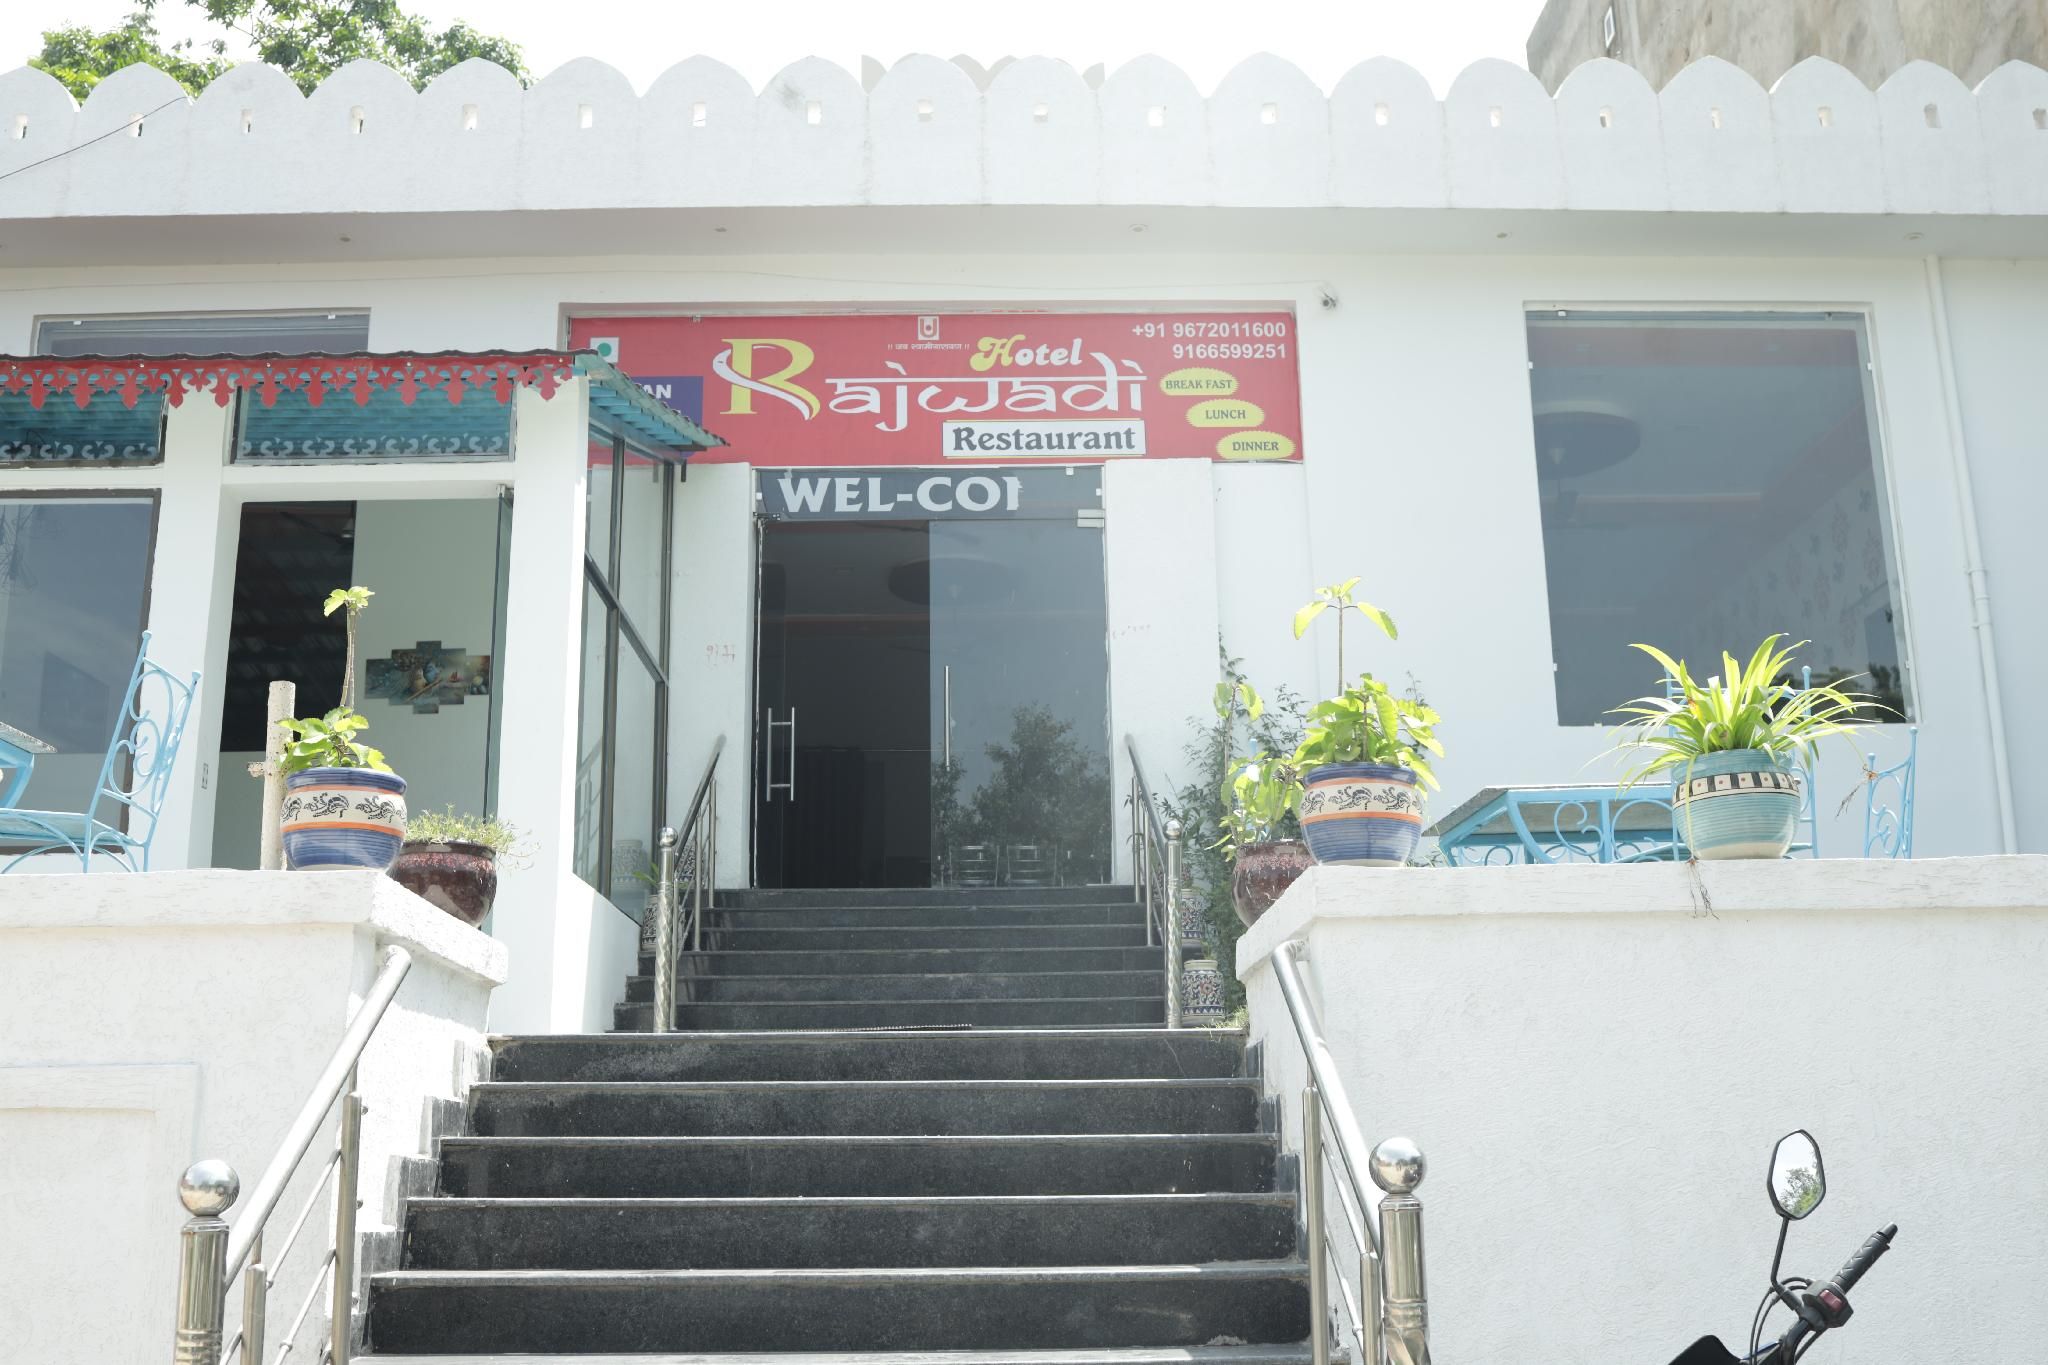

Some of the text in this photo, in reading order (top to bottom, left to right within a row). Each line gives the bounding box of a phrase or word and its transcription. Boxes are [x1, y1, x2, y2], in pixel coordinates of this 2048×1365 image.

[1132, 323, 1287, 338] +91 9672011600
[969, 334, 1083, 372] Hotel
[1172, 343, 1287, 359] 9166599251
[642, 384, 672, 399] AN
[712, 338, 1148, 432] Rajwadi
[1165, 378, 1233, 391] BREAK FAST
[1205, 409, 1246, 420] LUNCH
[952, 426, 1136, 452] Restaurant
[1231, 441, 1279, 453] DINNER
